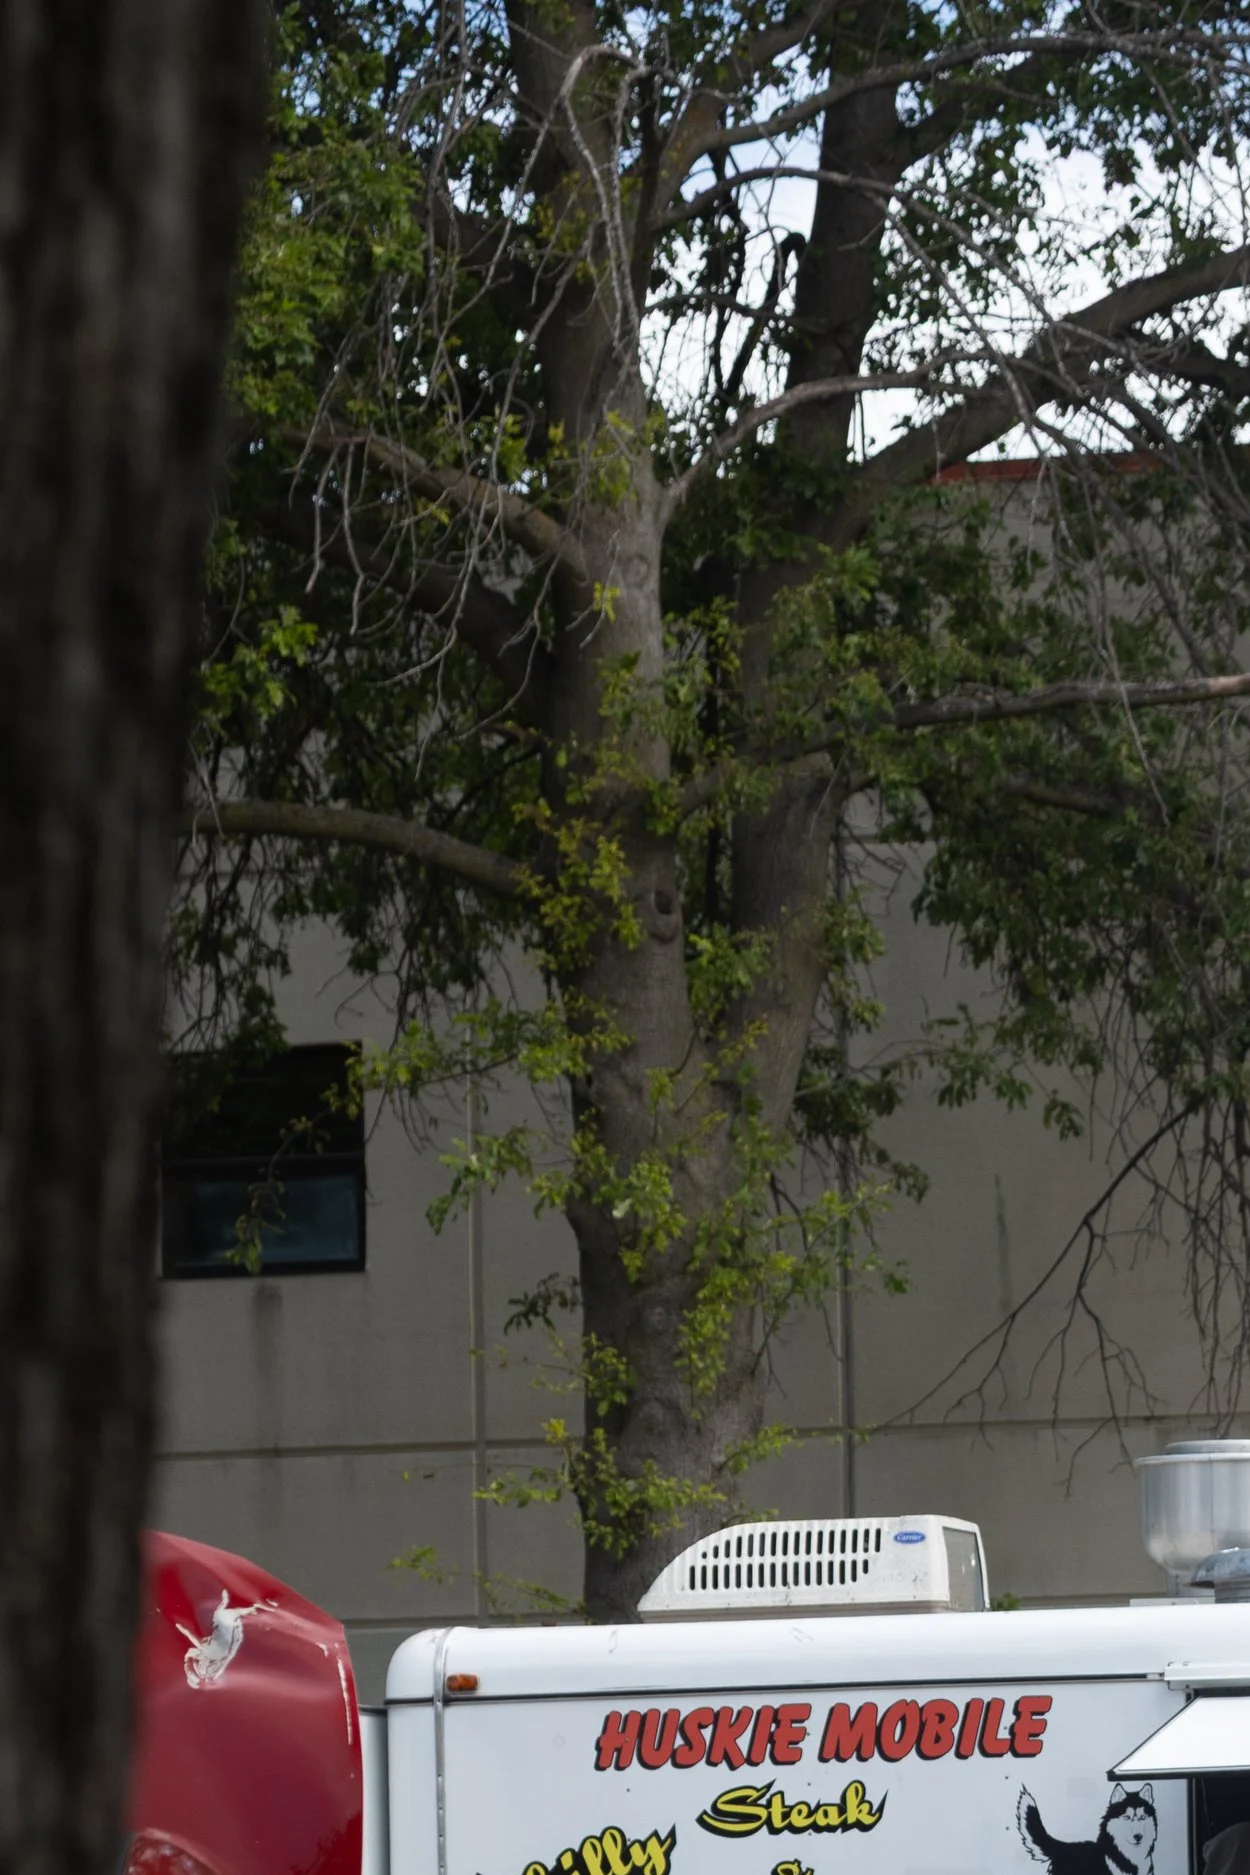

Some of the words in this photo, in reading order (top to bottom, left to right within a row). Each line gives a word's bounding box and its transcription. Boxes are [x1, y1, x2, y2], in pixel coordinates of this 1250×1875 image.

[595, 1703, 812, 1771] HUSKIE
[818, 1695, 1052, 1762] MOBILE
[695, 1778, 888, 1838] Steak
